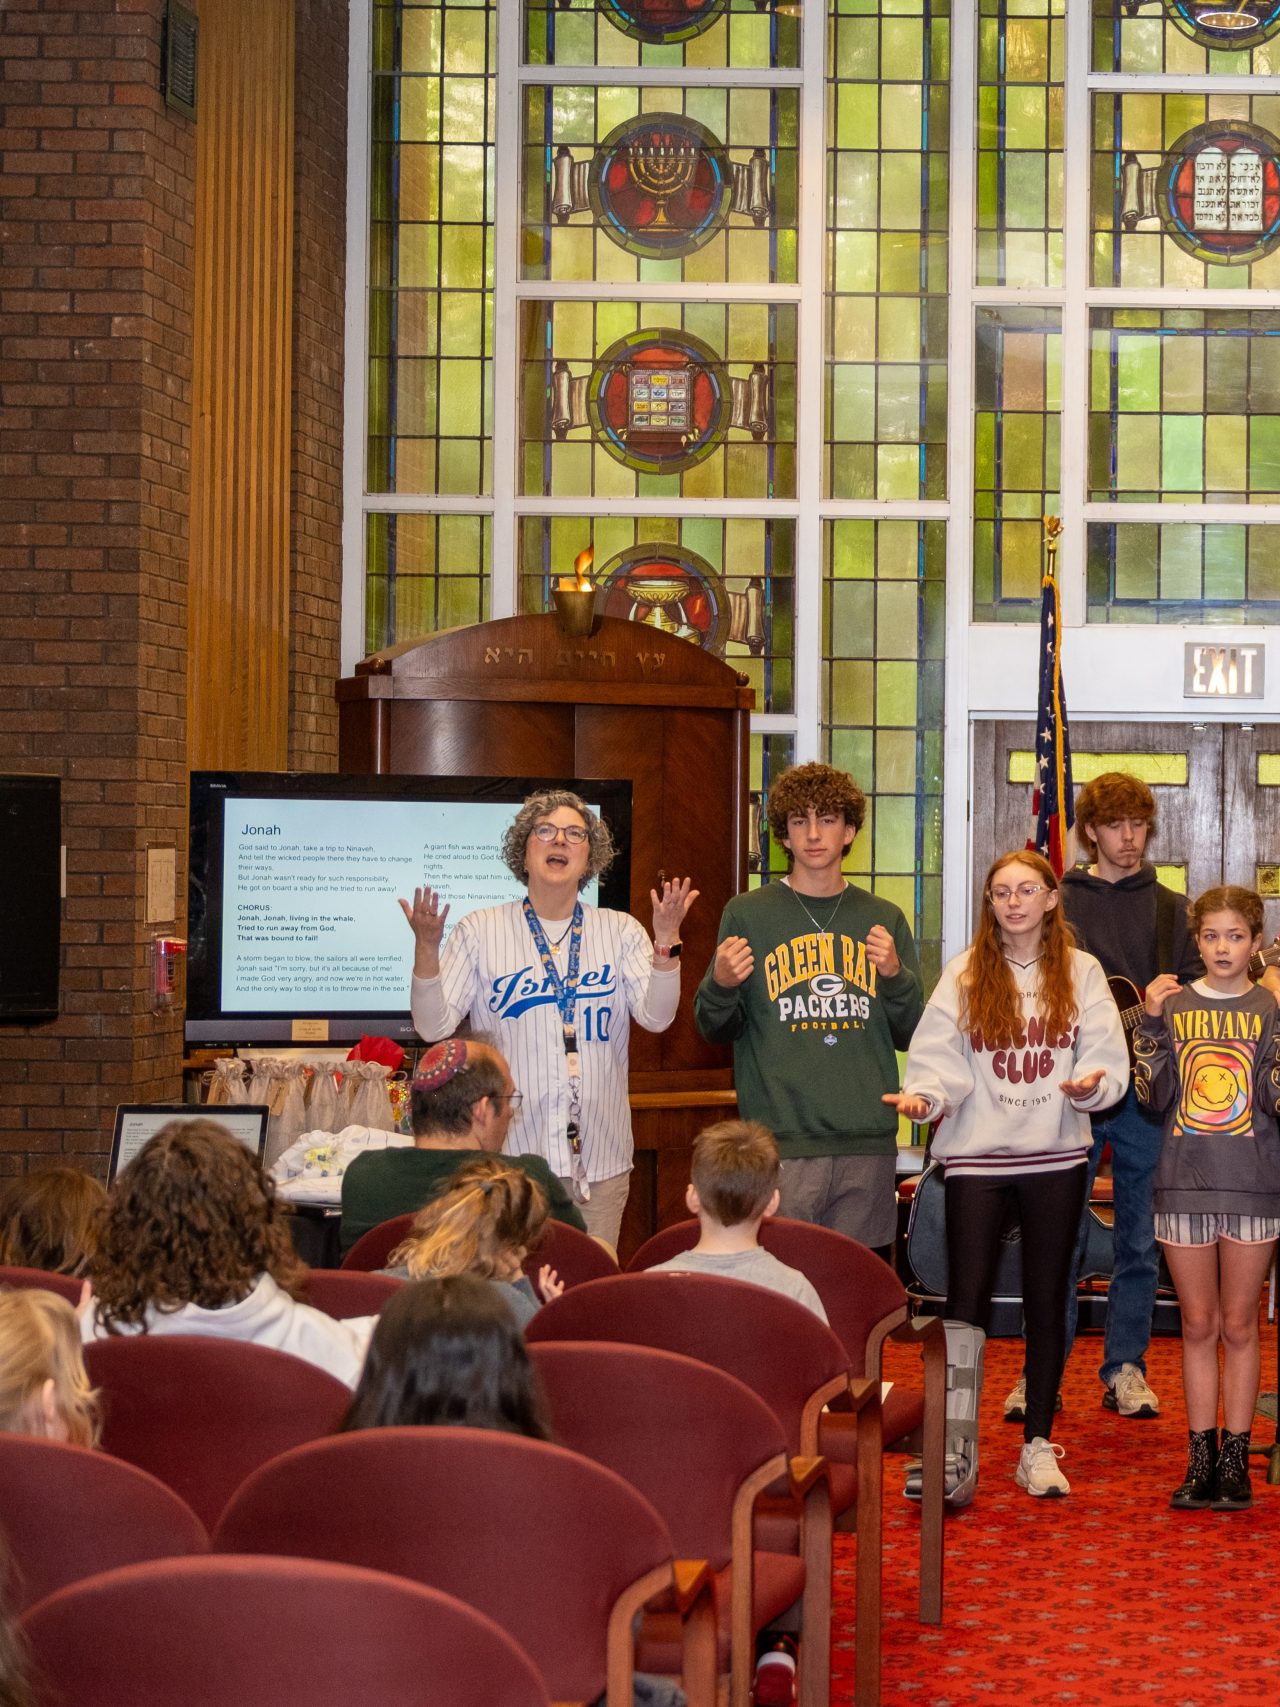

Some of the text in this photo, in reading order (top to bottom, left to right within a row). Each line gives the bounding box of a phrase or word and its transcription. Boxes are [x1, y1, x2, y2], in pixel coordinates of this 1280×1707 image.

[484, 647, 533, 665] היא
[1193, 648, 1258, 694] EXIT
[242, 824, 281, 836] Jonah
[764, 932, 834, 1002] GREEN
[584, 1006, 612, 1041] 10
[778, 994, 870, 1022] PACKERS
[1173, 1010, 1262, 1041] NIRVANA
[992, 1049, 1054, 1084] CLUB
[1000, 1094, 1052, 1107] SINCE 1987
